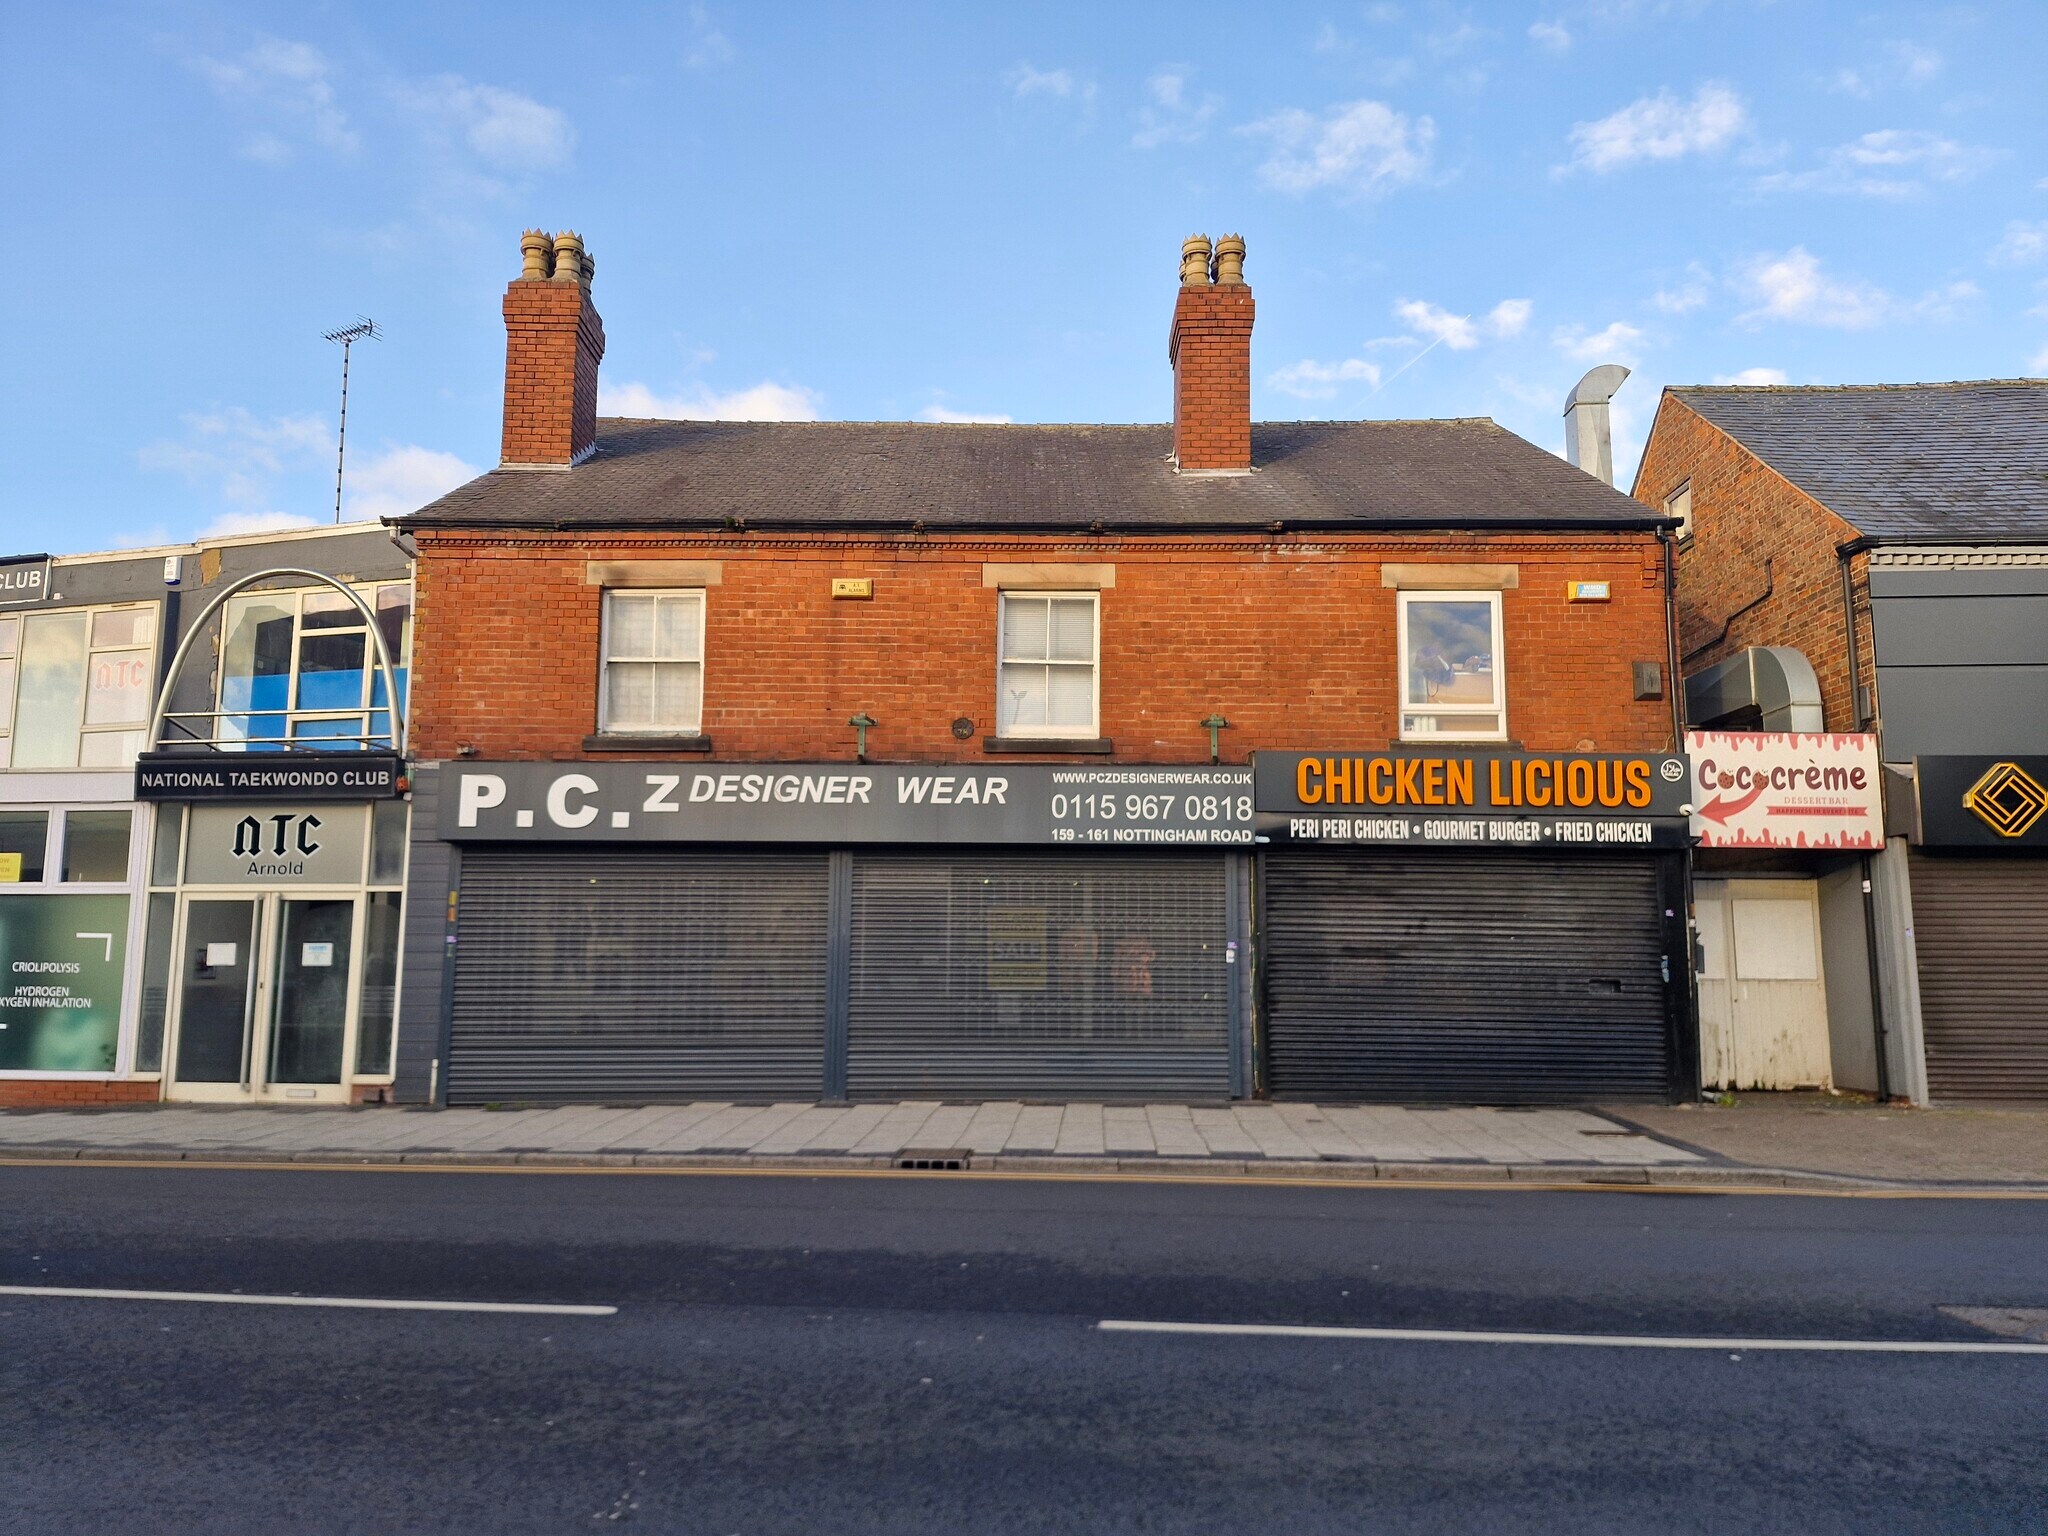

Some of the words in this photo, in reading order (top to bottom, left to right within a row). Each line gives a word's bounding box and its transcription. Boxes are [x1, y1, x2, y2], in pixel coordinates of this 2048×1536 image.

[141, 771, 225, 787] NATIONAL
[229, 770, 338, 787] TAEKWONDO
[342, 769, 390, 786] CLUB
[1052, 773, 1252, 785] WWW.PCZDESIGNERWEAR.CO.UK
[1297, 757, 1473, 806] CHICKEN
[1489, 759, 1653, 808] LICIOUS
[688, 774, 873, 804] DESIGNER
[897, 776, 1009, 805] WEAR
[1051, 794, 1116, 819] 0115
[1125, 795, 1176, 820] 967
[1184, 796, 1253, 822] 0818
[1784, 796, 1827, 805] DESSERT
[1051, 828, 1075, 841] 159
[1087, 829, 1109, 841] 161
[1113, 829, 1207, 842] NOTTINGHAM
[1210, 829, 1252, 843] ROAD
[1290, 818, 1319, 838] PERI
[1322, 819, 1351, 839] PERI
[1354, 819, 1409, 840] CHICKEN
[1423, 820, 1485, 841] GOURMET
[1489, 821, 1541, 842] BURGER
[1555, 821, 1593, 842] FRIED
[1595, 822, 1652, 843] CHICKEN
[246, 861, 304, 876] Arnold
[12, 961, 80, 974] CRIOLIPOLYSIS
[14, 985, 70, 997] HYDROGEN
[32, 997, 92, 1009] INHALATION
